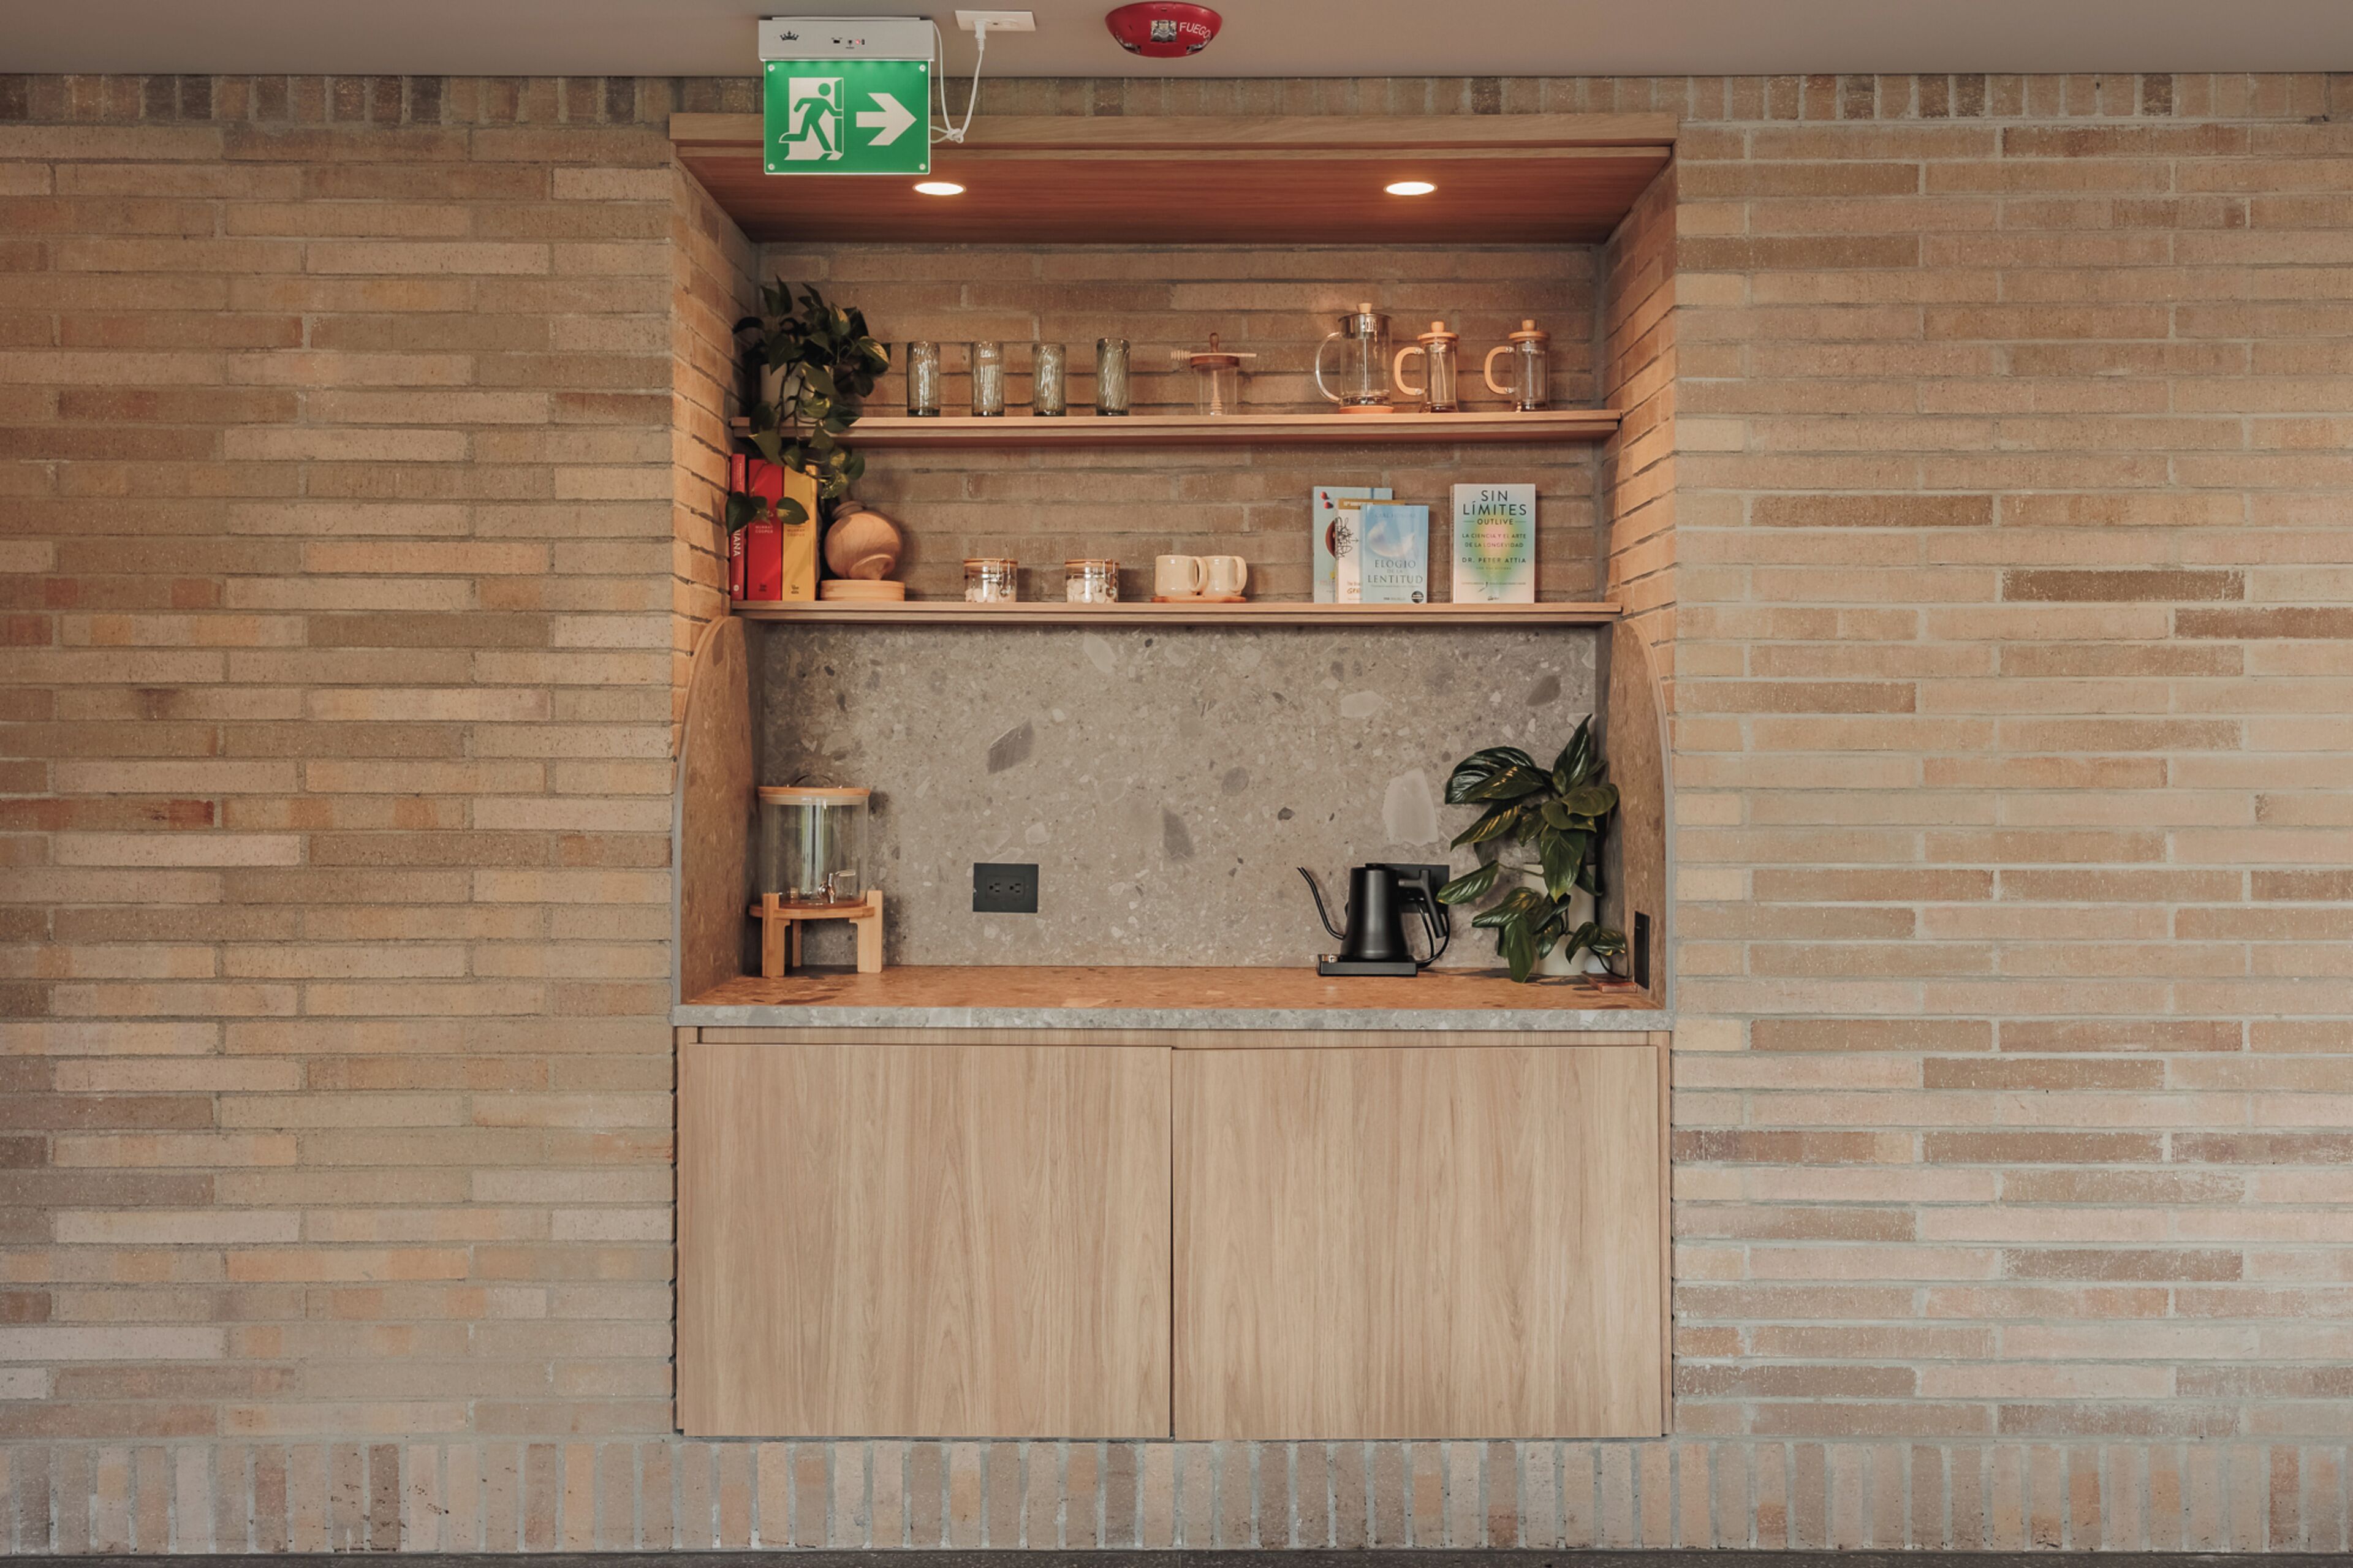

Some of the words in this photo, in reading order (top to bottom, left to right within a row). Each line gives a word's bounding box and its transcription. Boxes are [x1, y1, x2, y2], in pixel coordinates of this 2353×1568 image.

[1179, 21, 1211, 39] FUEGO
[1481, 490, 1508, 502] SIN
[1463, 501, 1527, 515] LÍMITES
[1374, 559, 1416, 569] ELOGIO
[1367, 574, 1423, 584] LENTITUD
